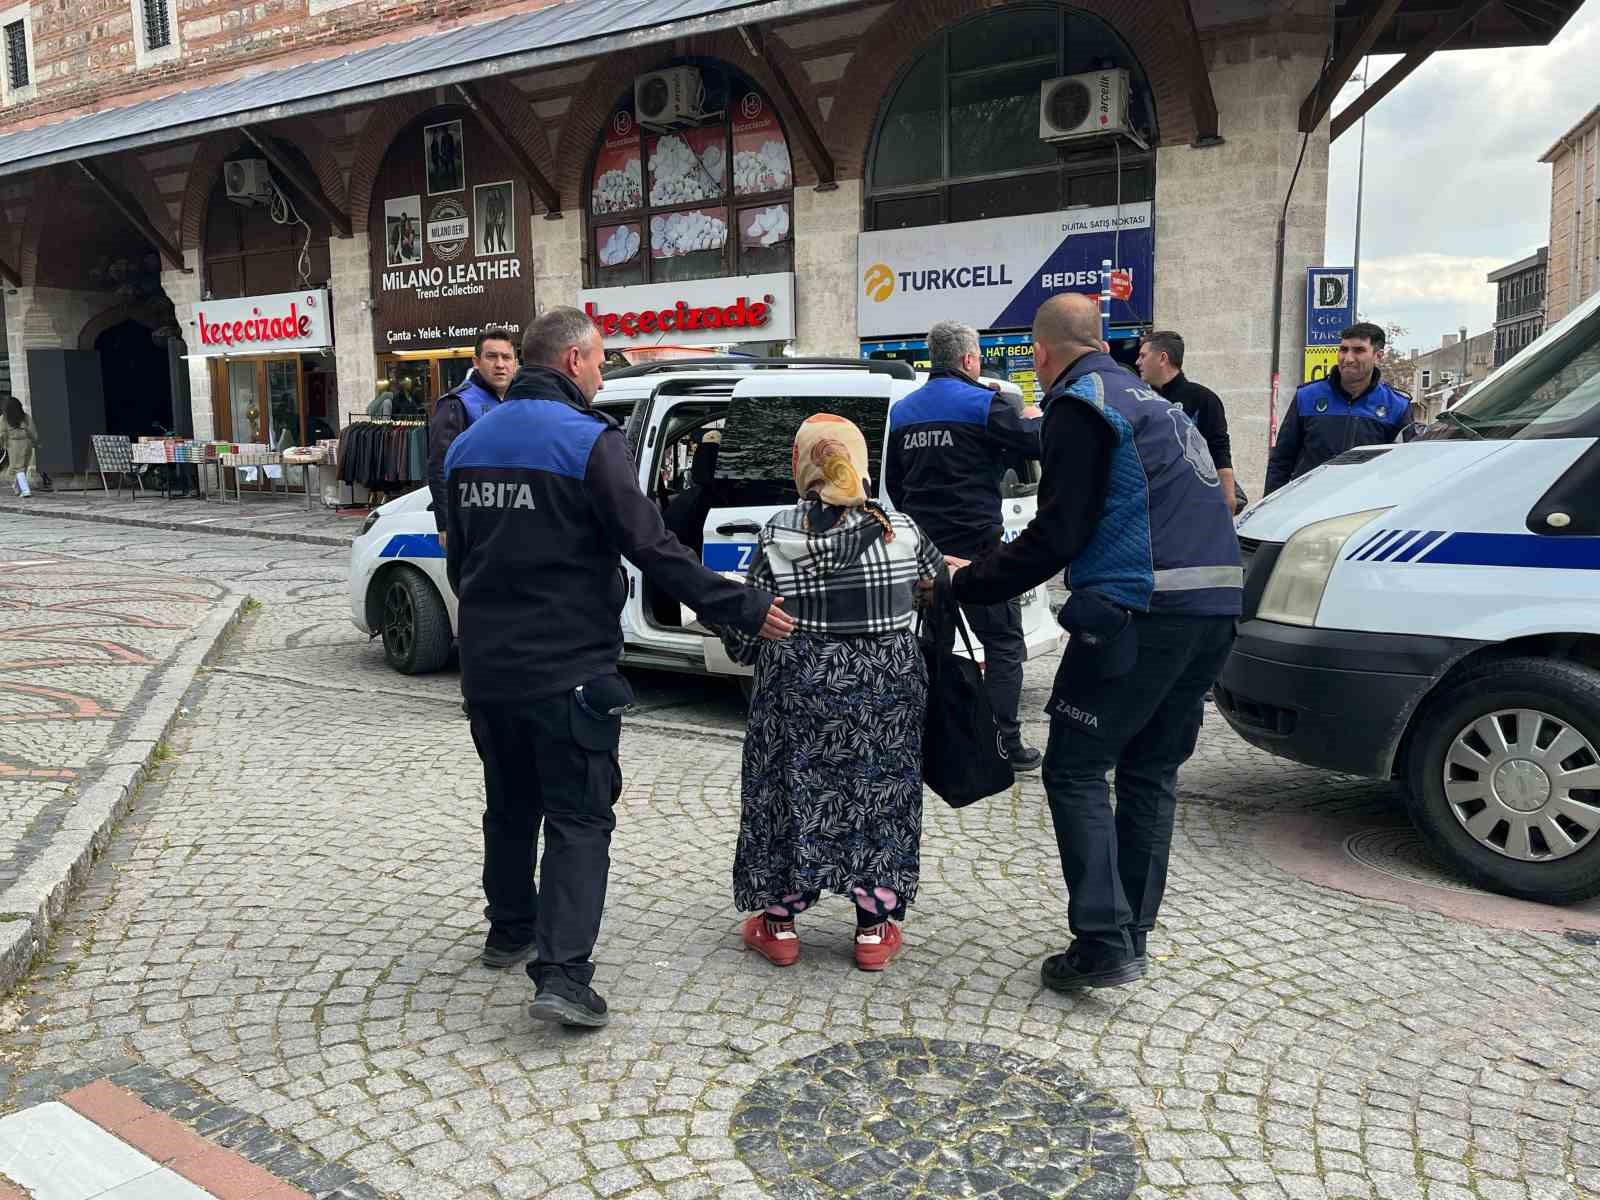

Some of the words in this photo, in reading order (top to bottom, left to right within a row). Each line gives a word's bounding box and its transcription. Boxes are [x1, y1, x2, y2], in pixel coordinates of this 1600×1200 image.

[448, 259, 521, 284] LEATHER
[898, 263, 1013, 292] TURKCELL
[416, 287, 440, 300] Trend
[441, 283, 485, 298] Collection
[198, 303, 310, 346] keçecizade
[386, 330, 411, 345] Çanta
[418, 327, 441, 340] Yelek
[448, 326, 478, 337] Kemer
[986, 346, 1006, 358] HAT
[903, 430, 954, 450] ZABITA
[458, 481, 536, 510] ZABITA
[1055, 699, 1098, 728] ZABITA
